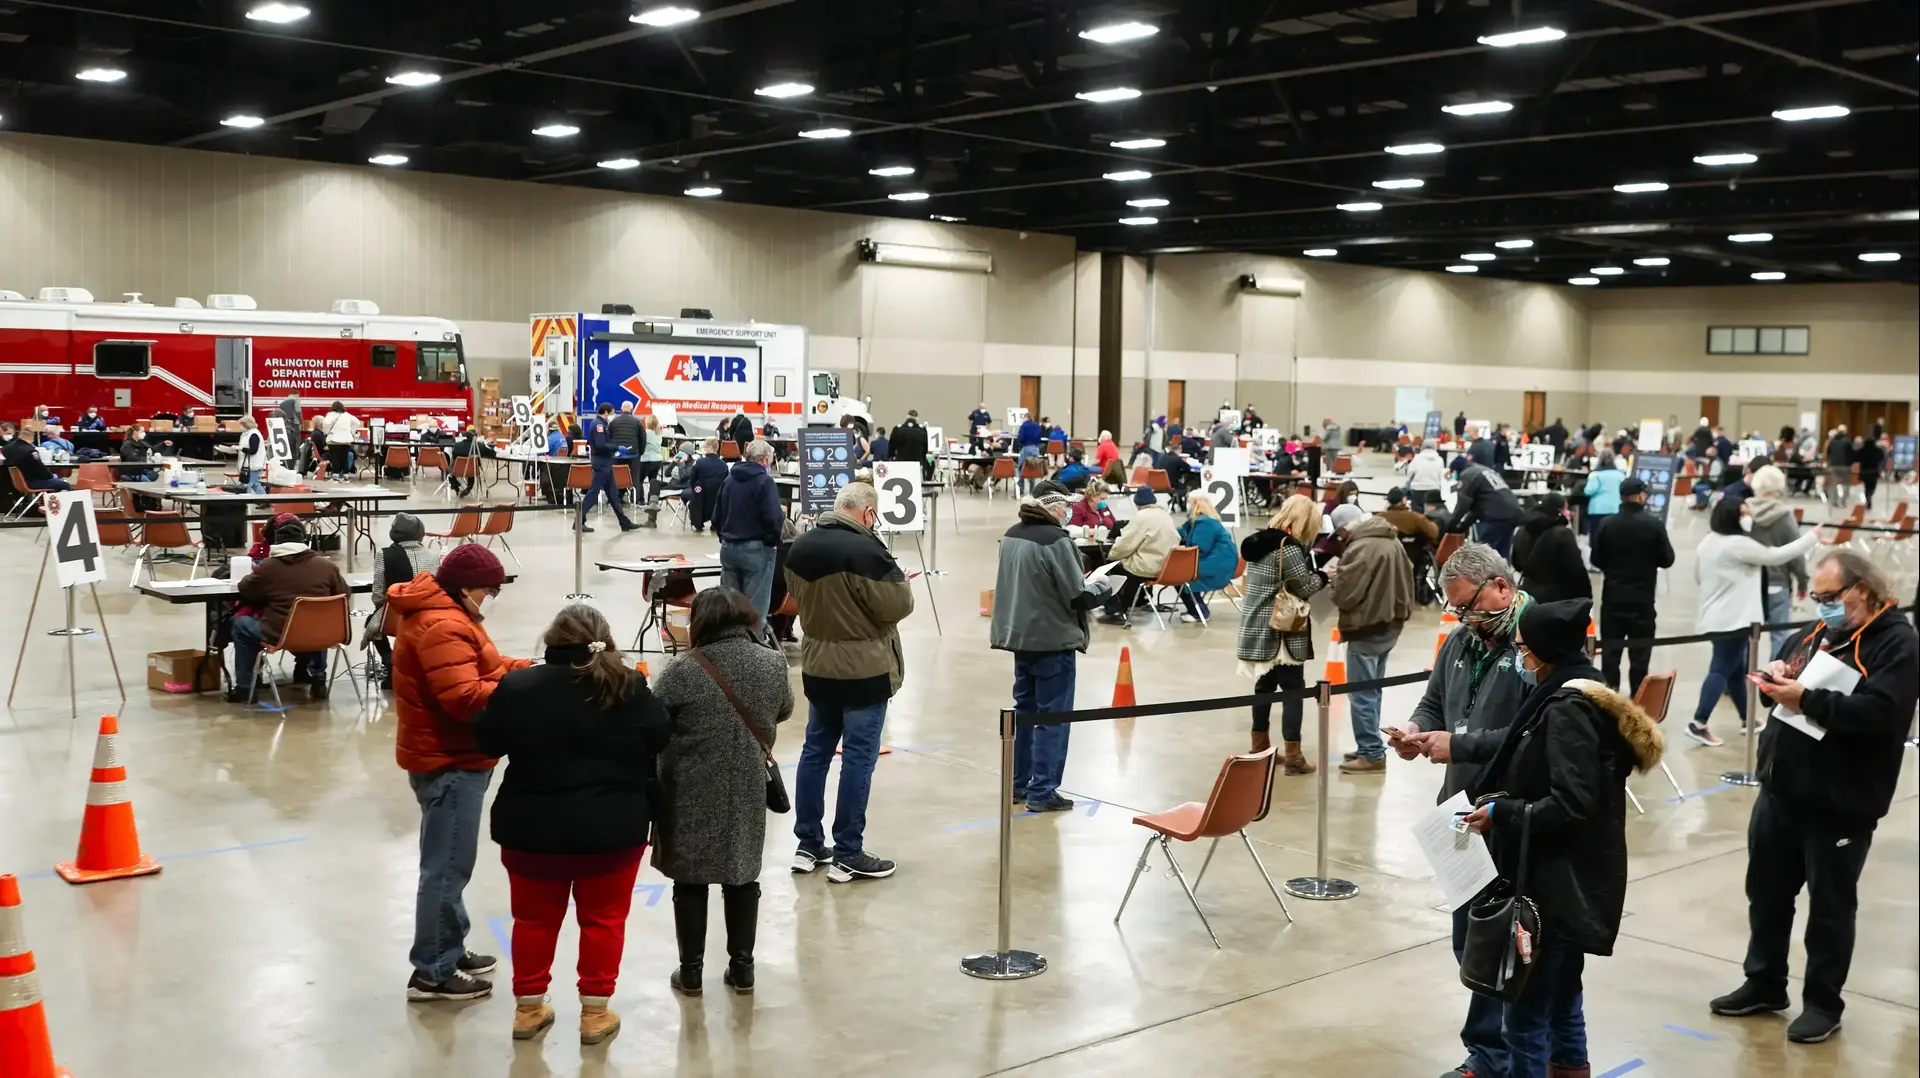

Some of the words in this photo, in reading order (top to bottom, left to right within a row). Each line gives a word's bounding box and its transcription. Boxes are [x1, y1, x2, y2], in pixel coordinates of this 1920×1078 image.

[696, 328, 734, 336] EMERGENCY
[735, 329, 762, 337] SUPPORT
[264, 358, 323, 367] ARLINGTON
[326, 359, 349, 368] FIRE
[665, 354, 747, 383] AMR
[272, 369, 341, 378] DEPARTMENT
[258, 379, 312, 388] COMMAND
[314, 380, 354, 389] CENTER
[682, 400, 710, 410] Medical
[516, 402, 530, 423] 9
[272, 427, 288, 458] 5
[533, 423, 546, 449] 8
[805, 448, 811, 461] 1
[826, 447, 835, 461] 2
[1526, 450, 1551, 467] 13
[807, 474, 815, 488] 3
[828, 474, 837, 488] 4
[881, 477, 917, 526] 3
[1207, 480, 1236, 523] 2
[56, 500, 99, 573] 4
